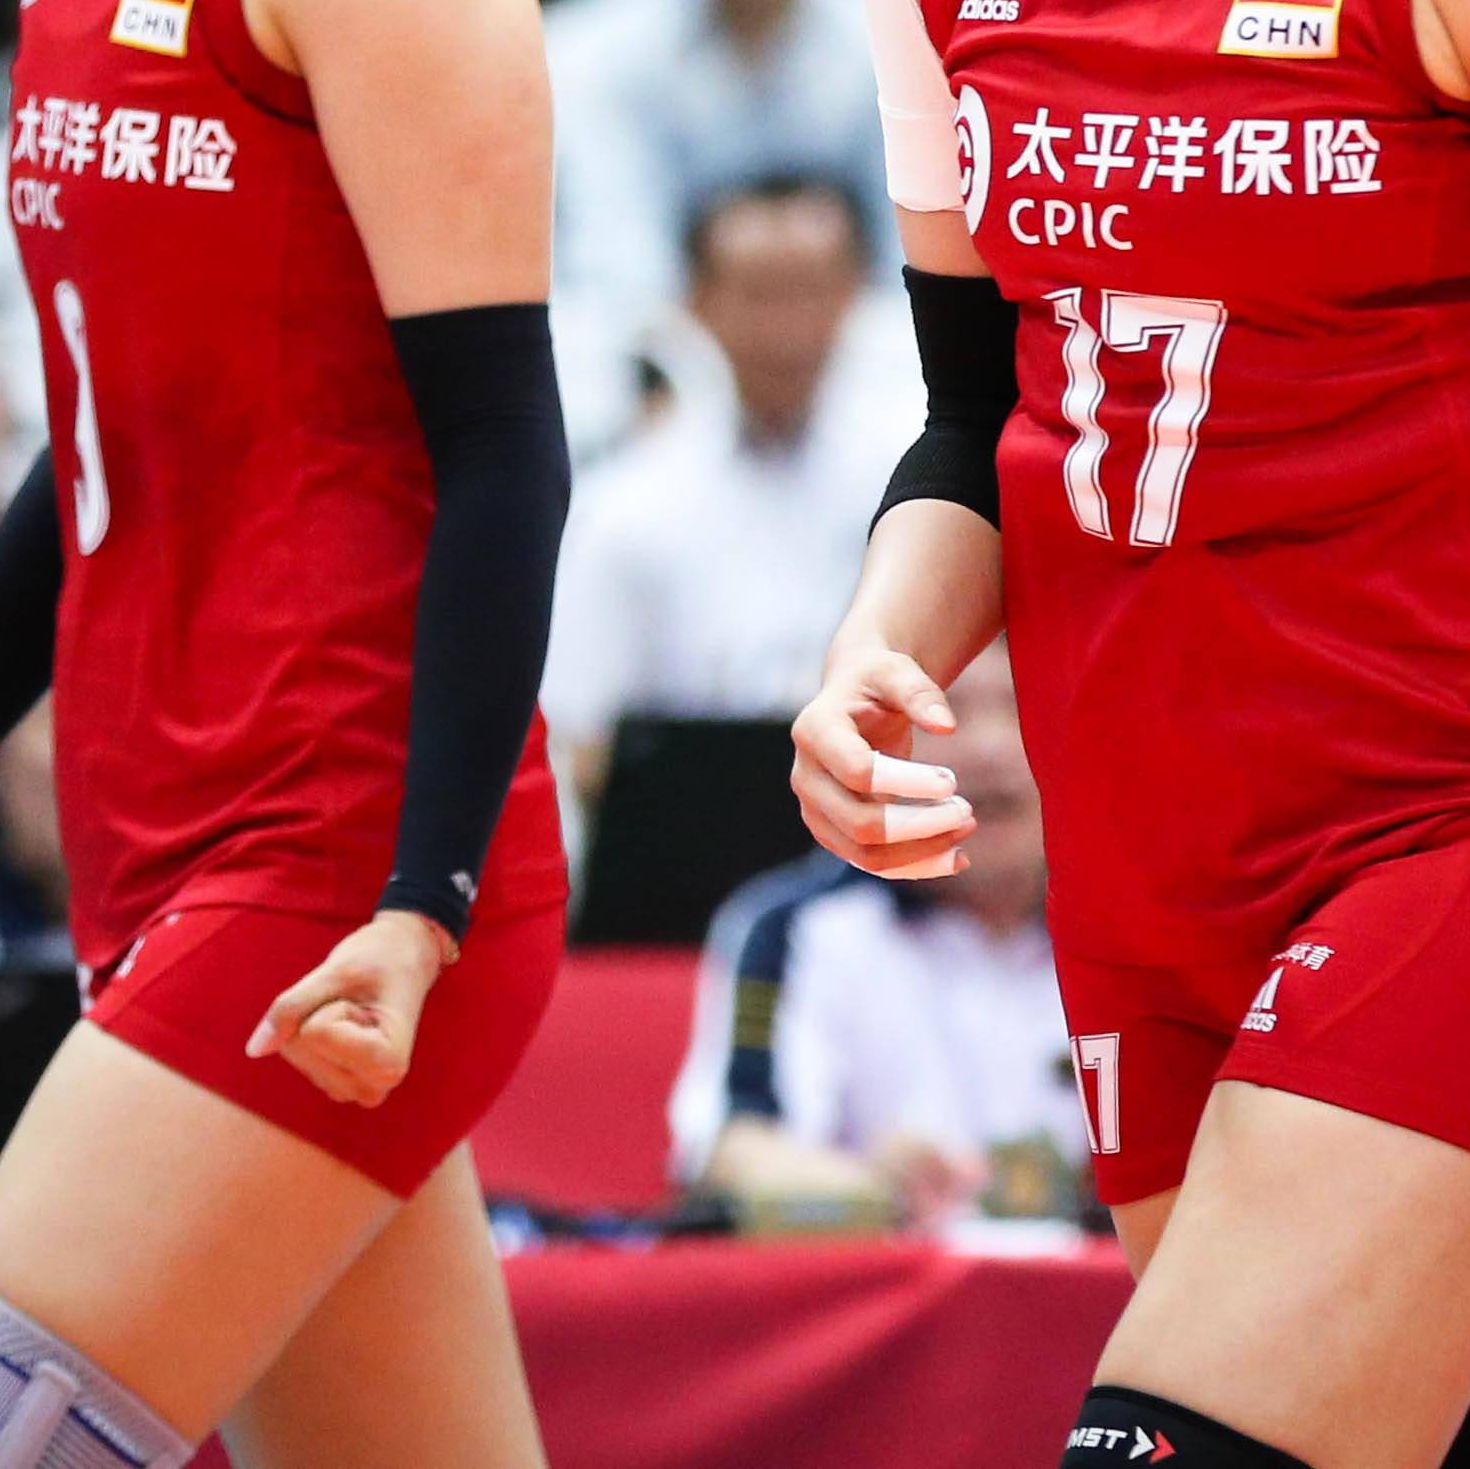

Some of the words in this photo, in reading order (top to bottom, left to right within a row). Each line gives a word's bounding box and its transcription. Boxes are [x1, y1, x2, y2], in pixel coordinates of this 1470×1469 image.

[123, 5, 178, 39] CHN
[1236, 16, 1322, 47] CHN
[11, 94, 238, 193] 太平洋保险
[1006, 107, 1383, 195] 太平洋保险
[1007, 198, 1133, 251] CPIC
[1041, 286, 1228, 548] 17
[1065, 1426, 1129, 1451] MST
